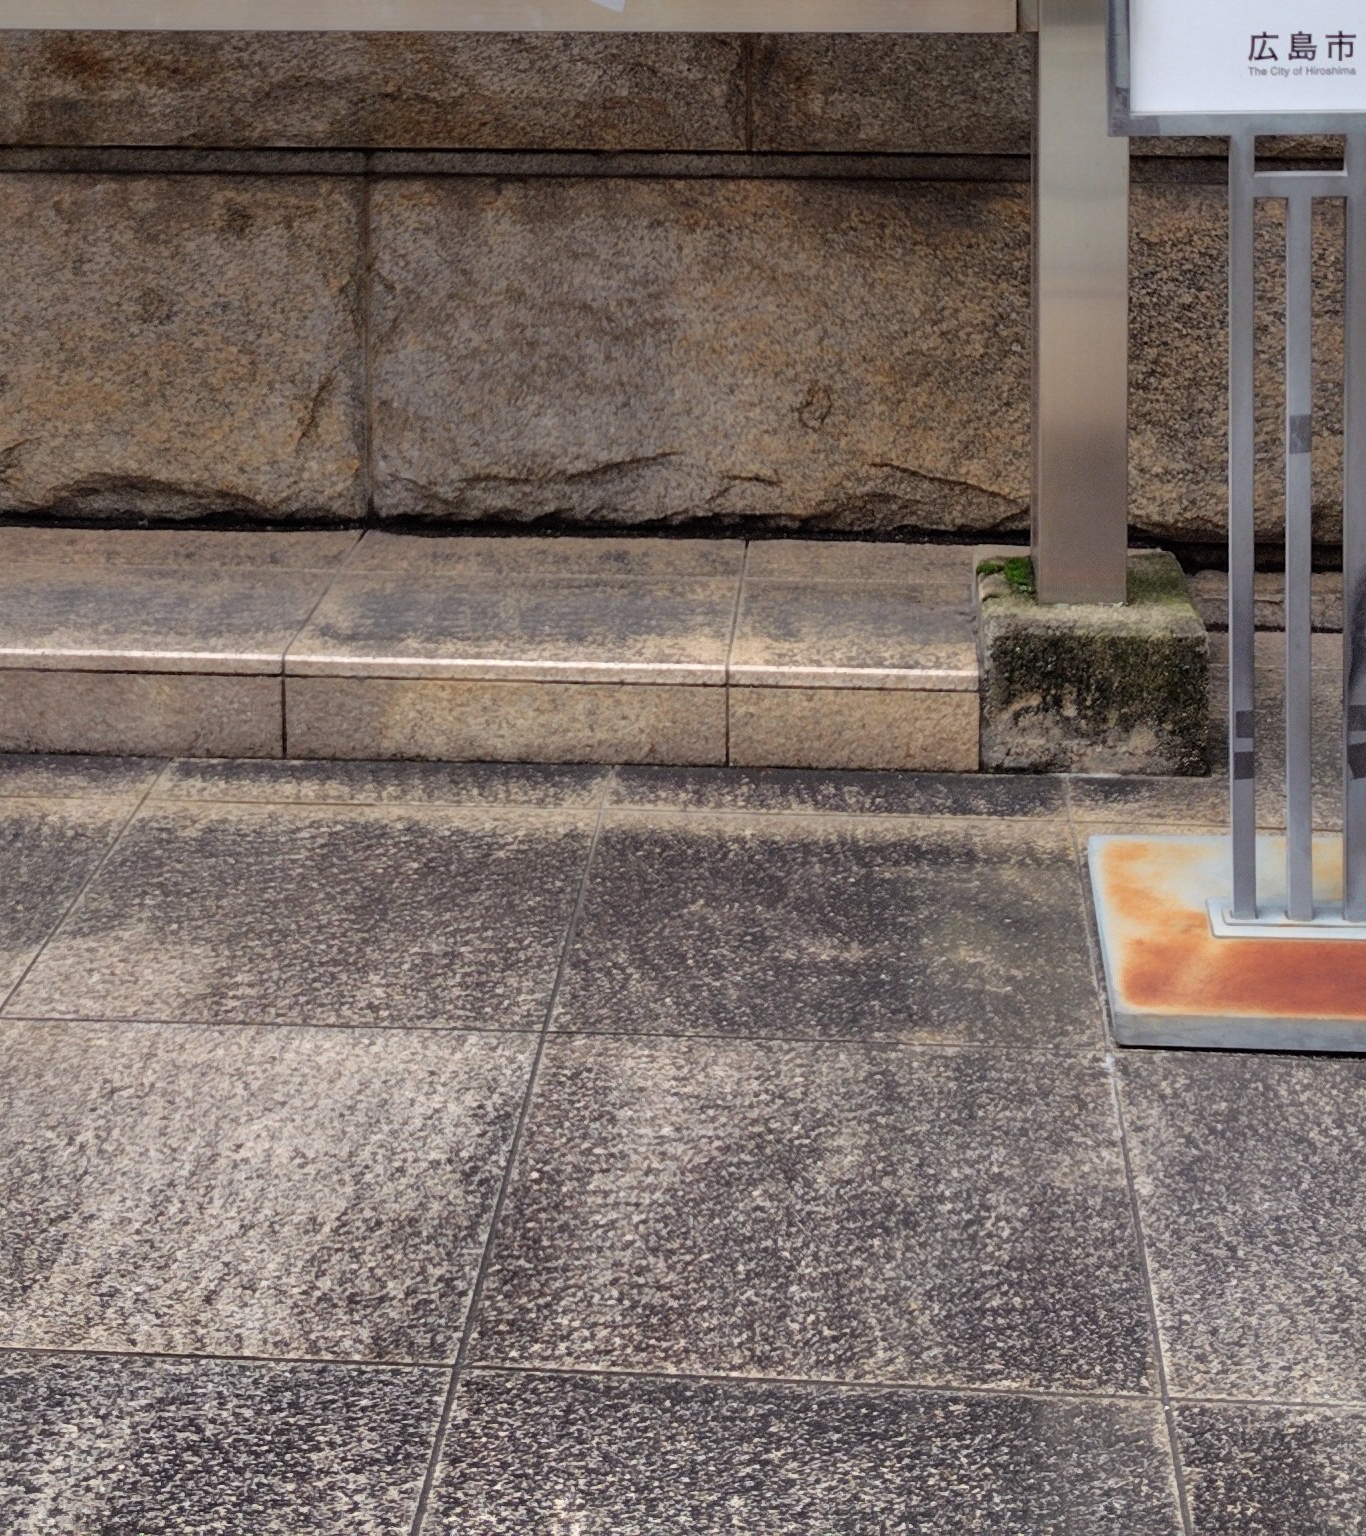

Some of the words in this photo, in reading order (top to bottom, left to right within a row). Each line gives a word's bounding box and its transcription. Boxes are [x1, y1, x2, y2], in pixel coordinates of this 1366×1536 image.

[1247, 31, 1357, 62] 広島市
[1248, 66, 1268, 77] The
[1269, 66, 1290, 79] City
[1292, 66, 1304, 77] of
[1305, 66, 1357, 77] Hiroshima
